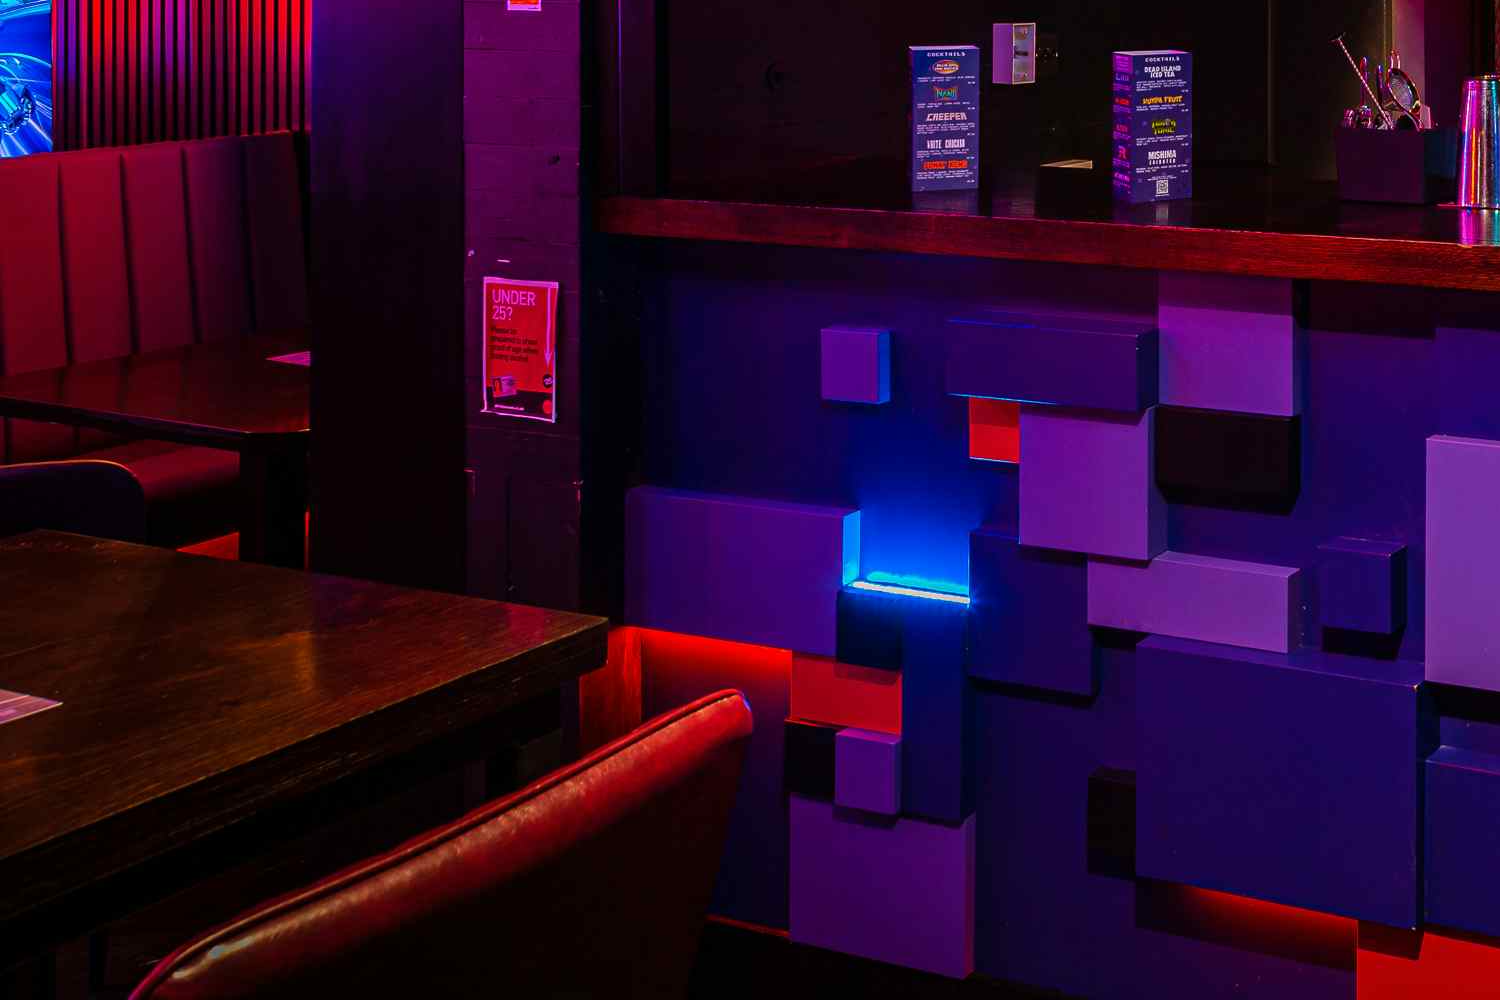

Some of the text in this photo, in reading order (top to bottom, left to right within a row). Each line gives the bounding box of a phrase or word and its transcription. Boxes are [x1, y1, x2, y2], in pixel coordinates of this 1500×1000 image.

[926, 112, 968, 122] CREEPER
[1148, 149, 1177, 160] MISHIMA
[492, 289, 536, 305] UNDER
[491, 305, 513, 321] 25?
